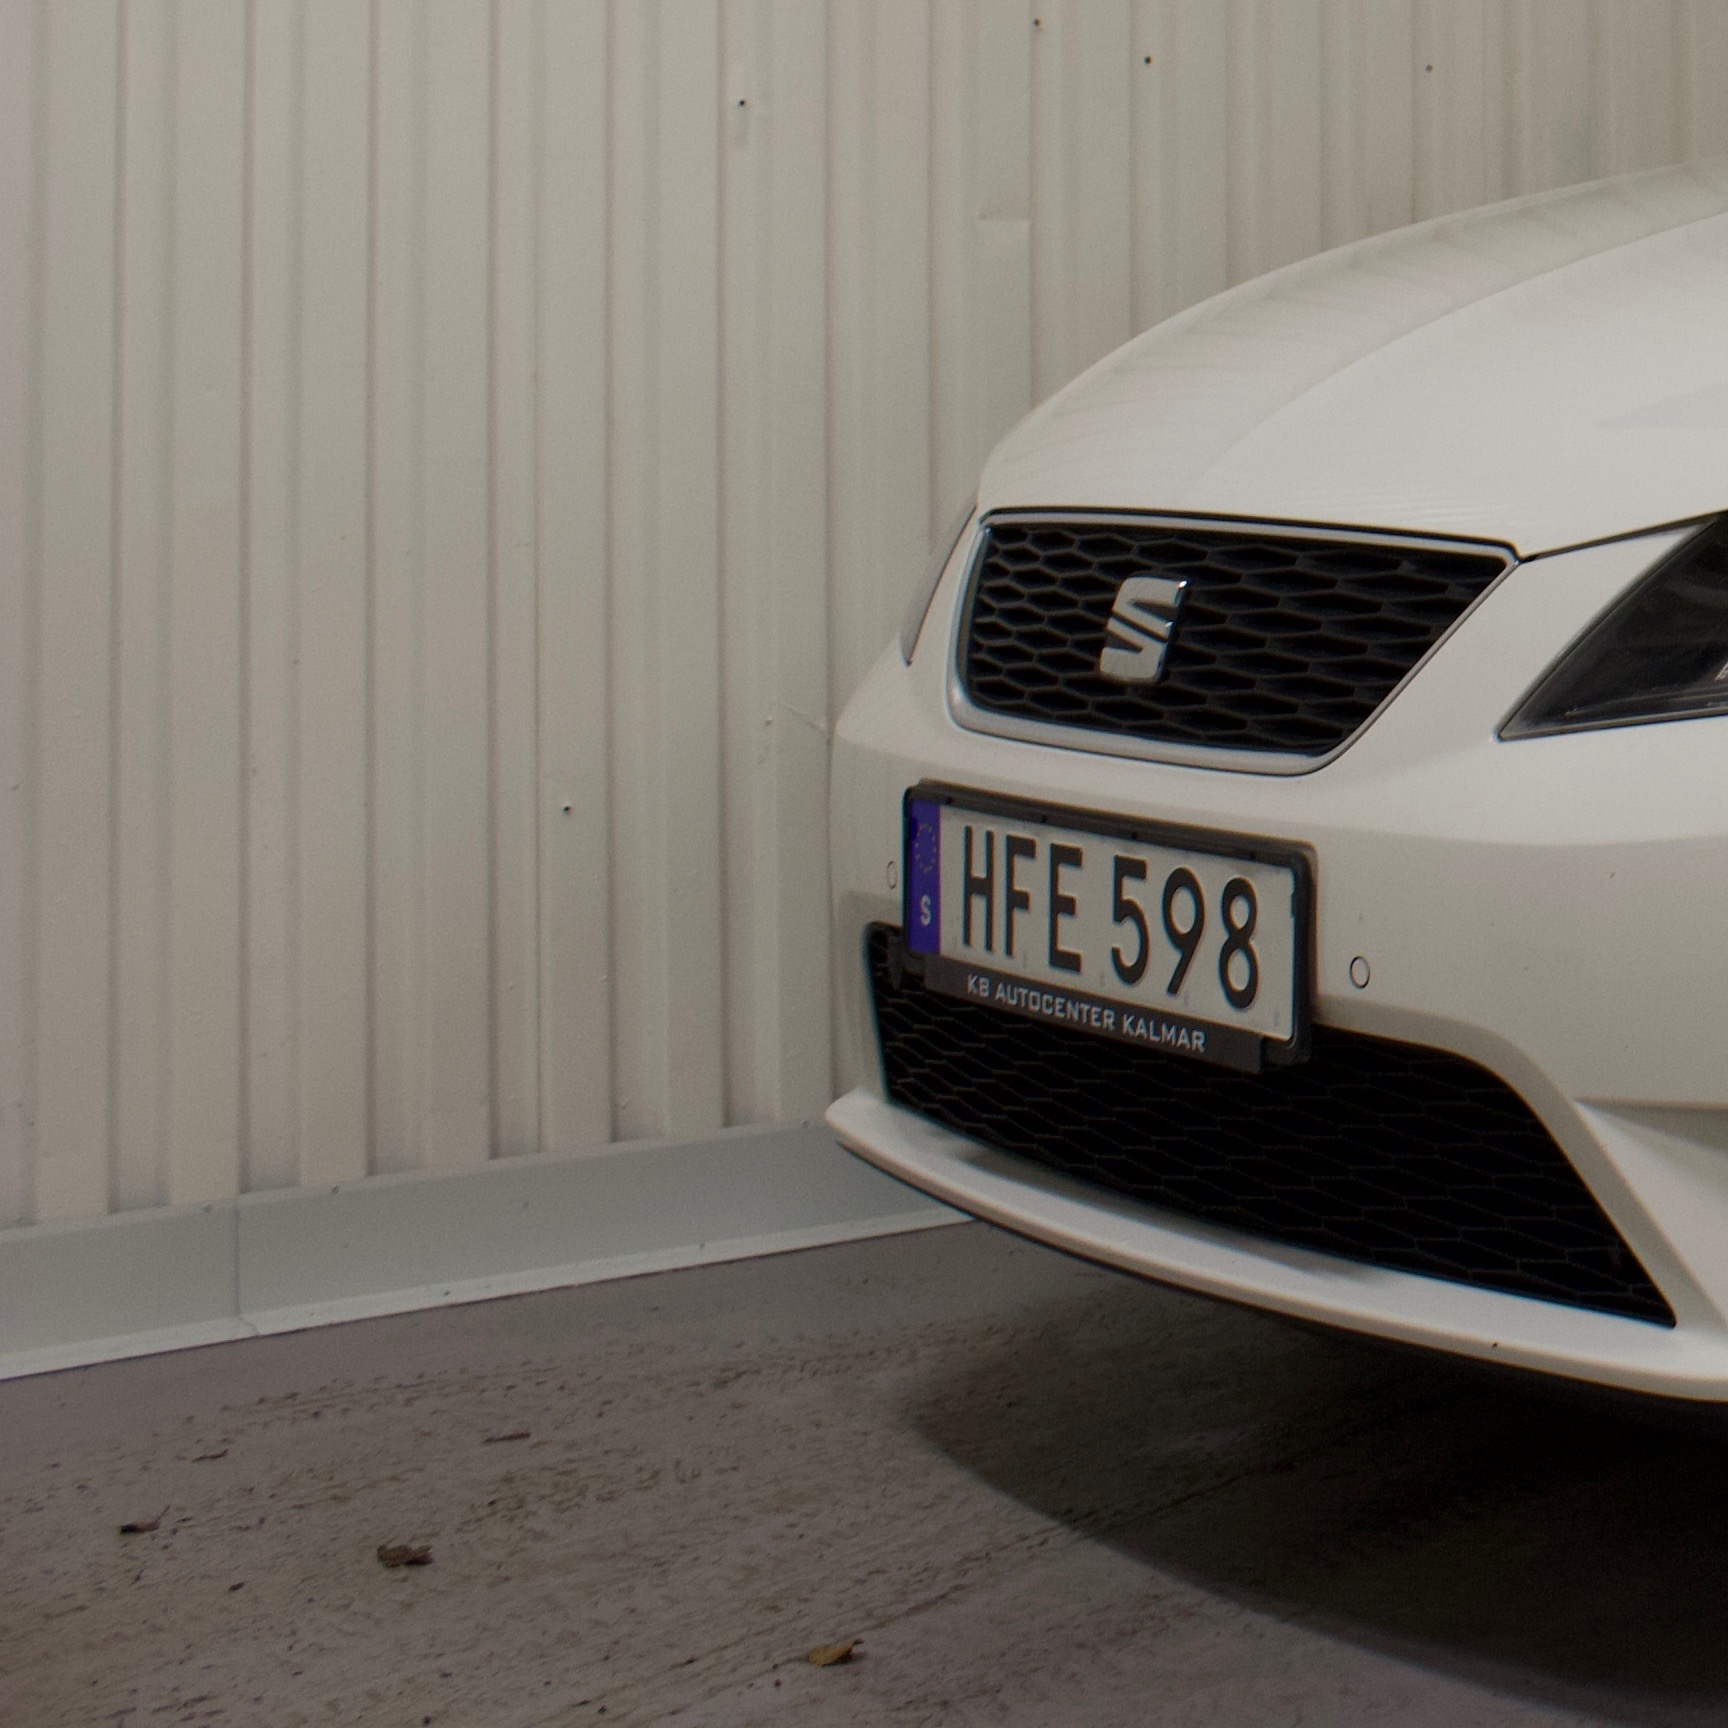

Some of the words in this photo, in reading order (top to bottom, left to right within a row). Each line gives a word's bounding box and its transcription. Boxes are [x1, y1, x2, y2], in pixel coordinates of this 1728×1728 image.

[918, 893, 933, 927] S
[963, 824, 1084, 974] HFE
[1110, 854, 1260, 1012] 598
[966, 972, 991, 999] KB
[994, 984, 1116, 1029] AUTOCENTER
[1122, 1011, 1207, 1054] KALMAR
